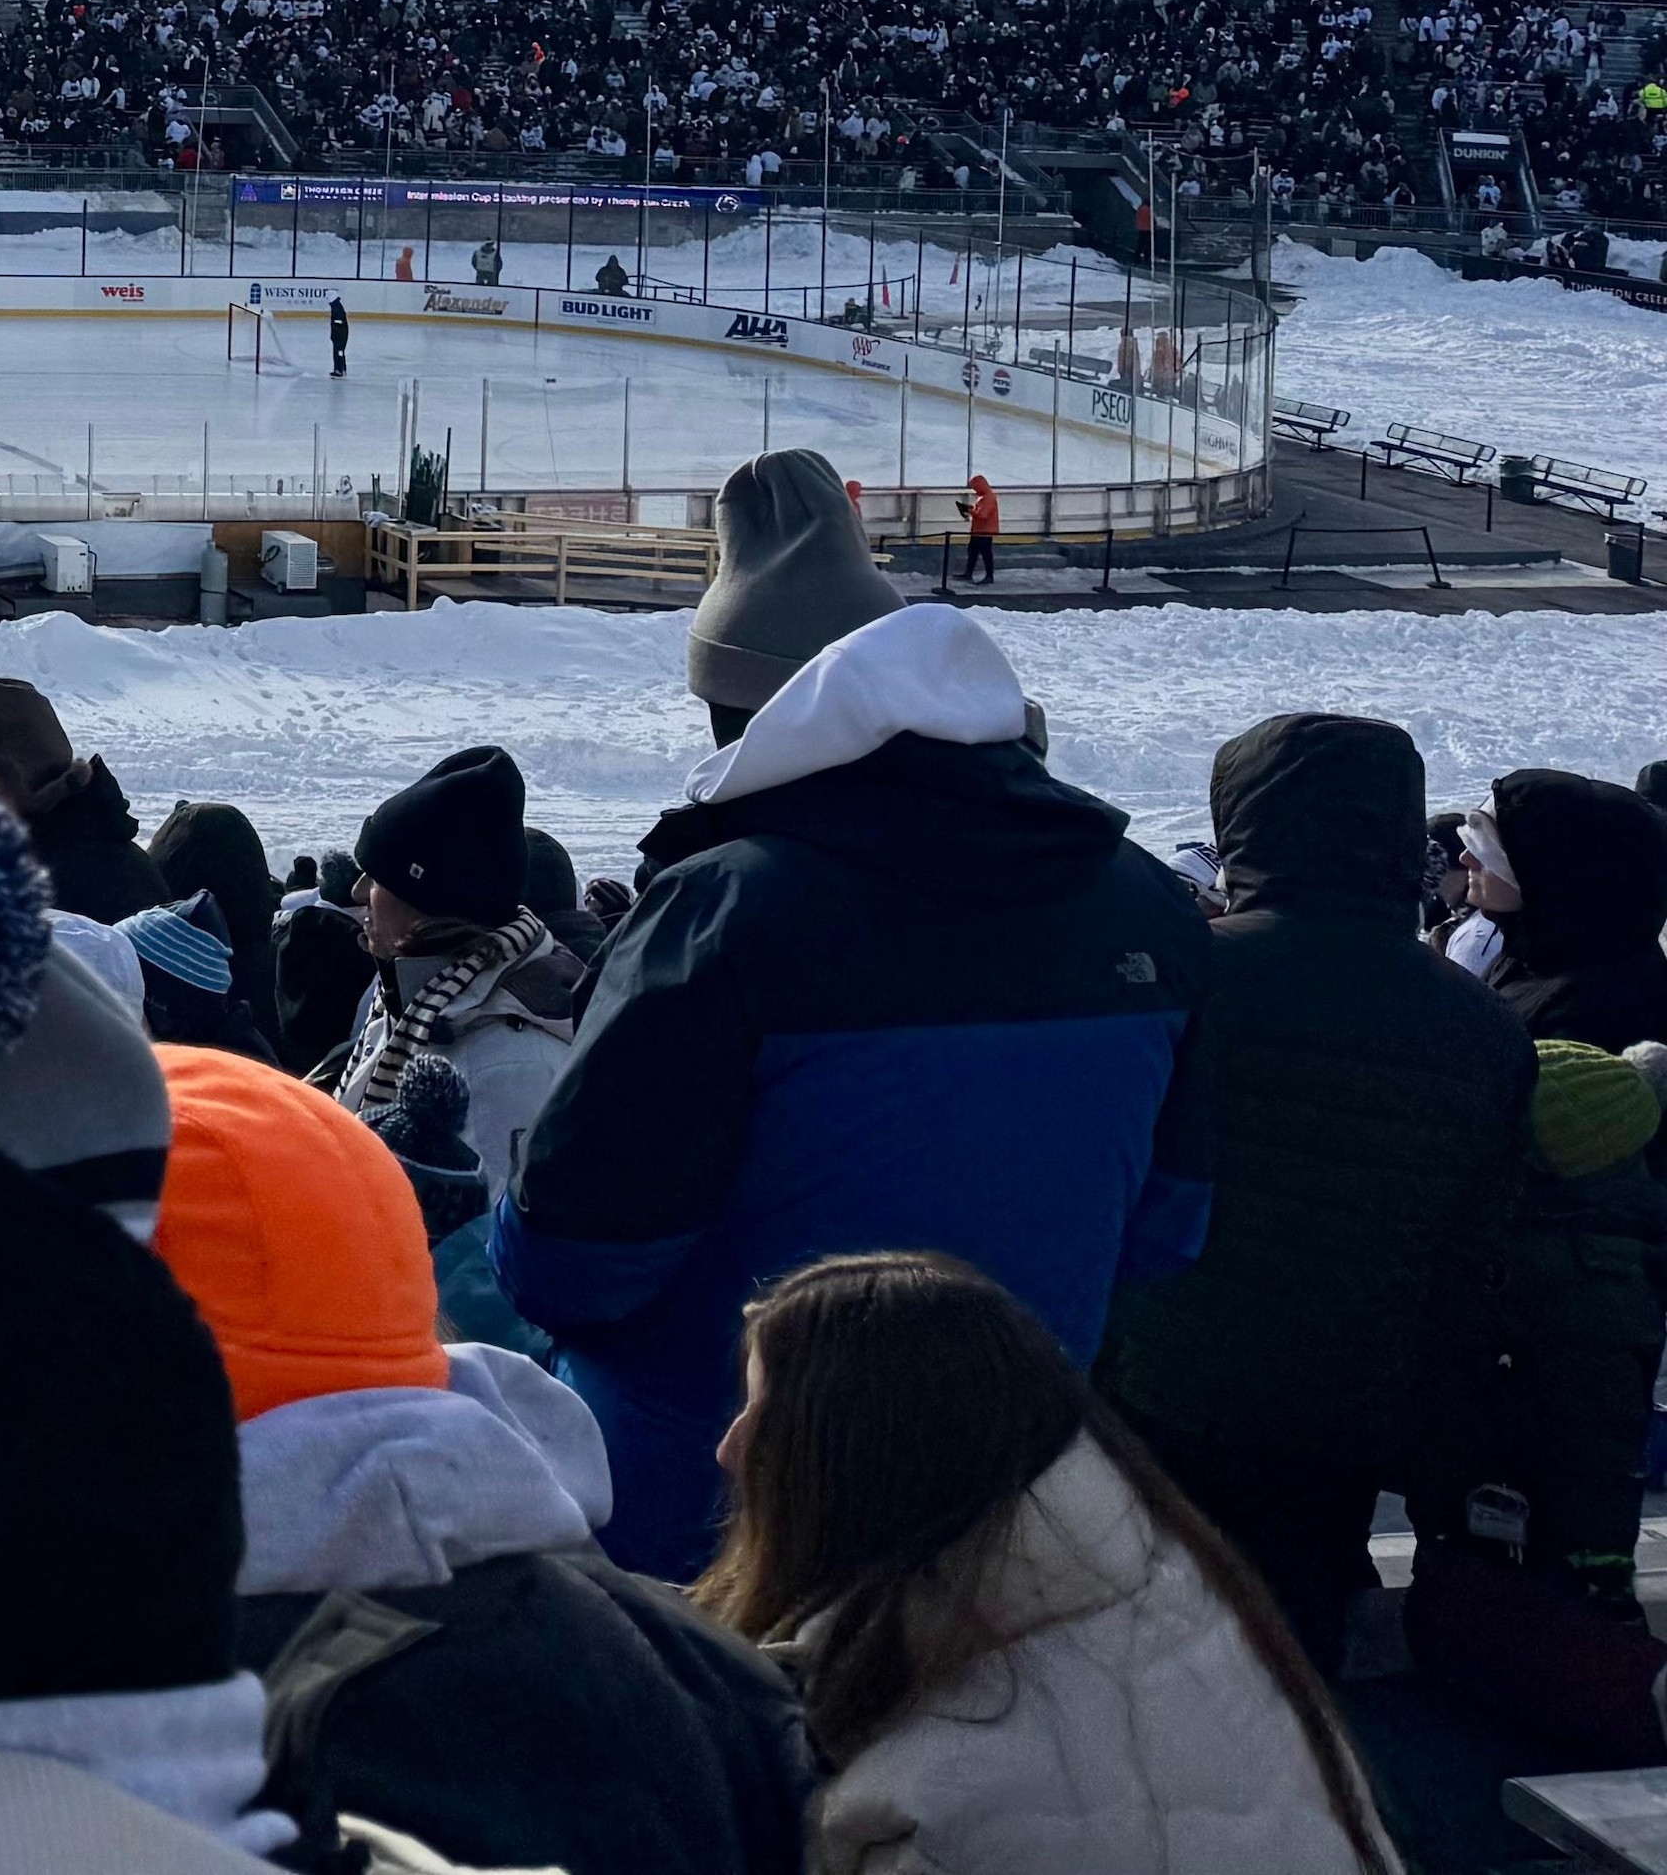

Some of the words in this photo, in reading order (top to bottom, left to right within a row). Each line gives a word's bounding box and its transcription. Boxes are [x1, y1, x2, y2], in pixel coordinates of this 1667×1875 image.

[101, 283, 144, 297] weis
[265, 288, 296, 297] WEST
[562, 301, 600, 315] BUD
[602, 304, 653, 320] LIGHT
[725, 314, 787, 337] AHA
[1092, 389, 1132, 423] PSECU
